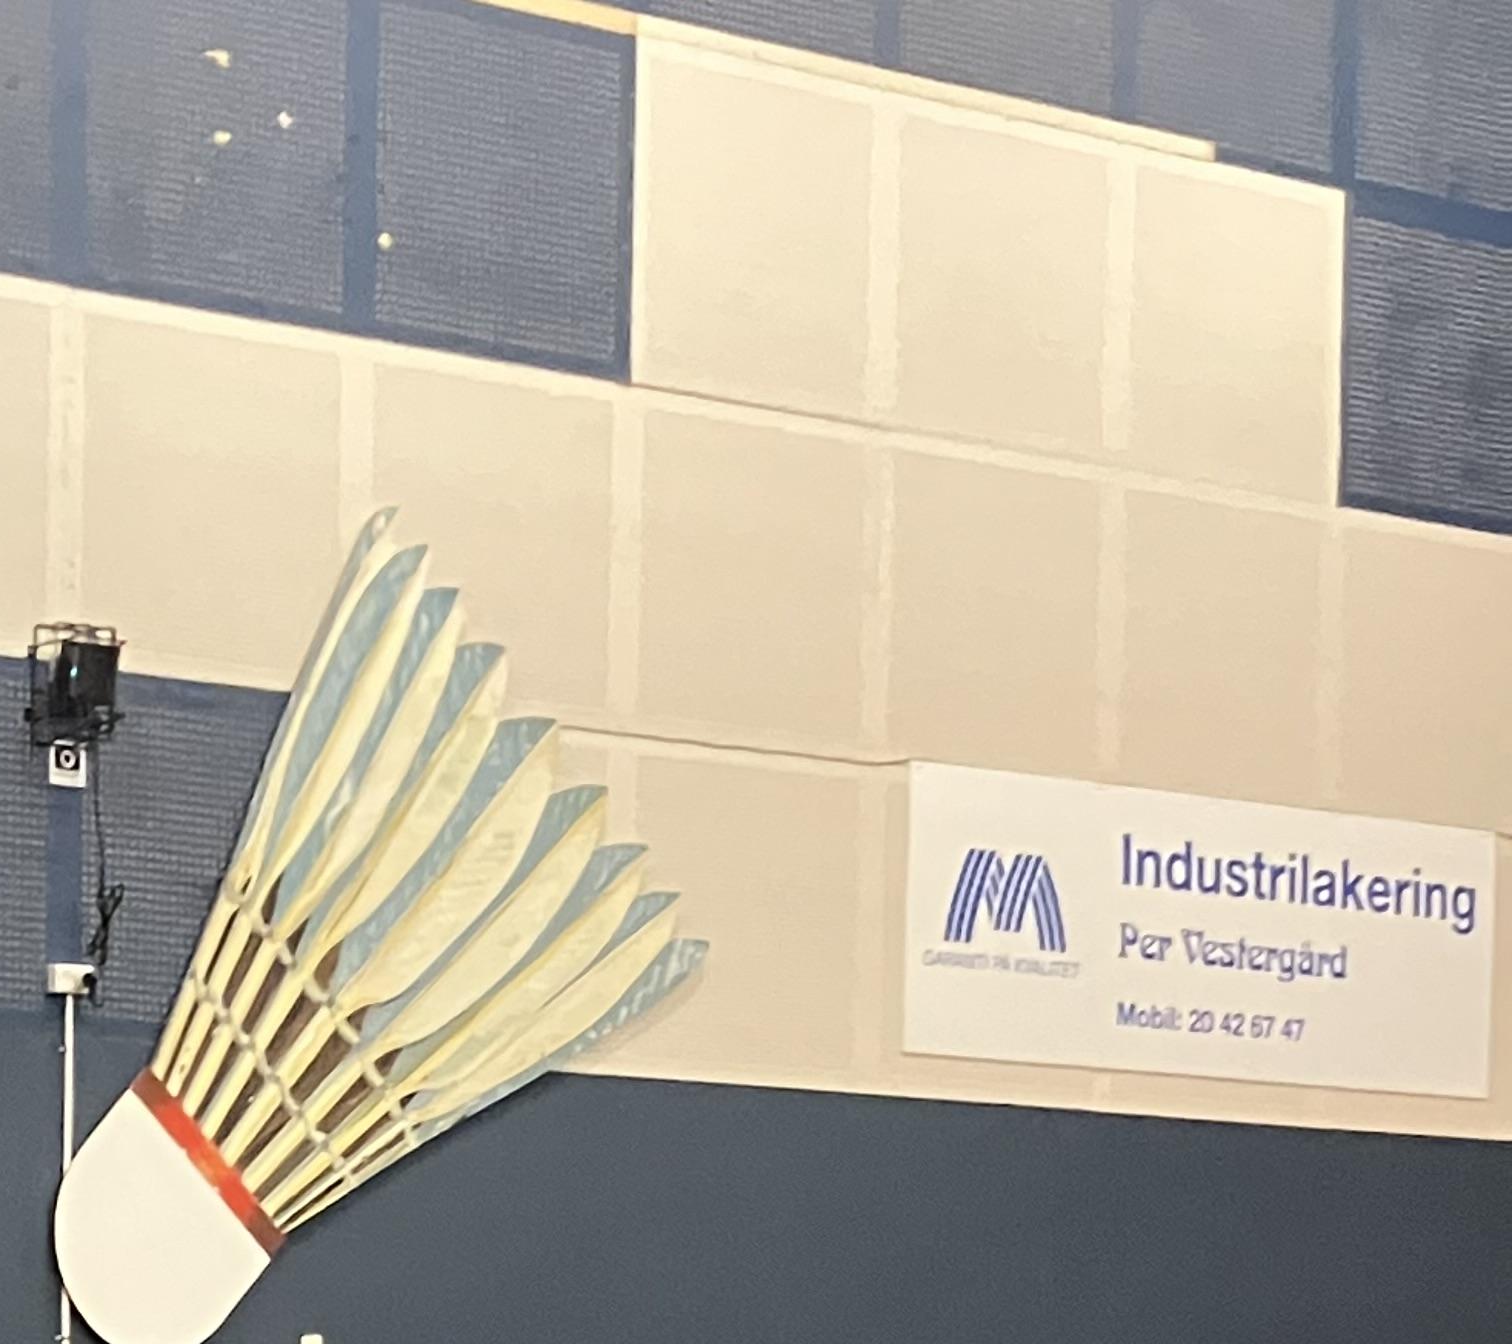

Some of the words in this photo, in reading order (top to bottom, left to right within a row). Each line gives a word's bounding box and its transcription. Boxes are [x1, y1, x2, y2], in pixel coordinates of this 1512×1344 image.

[1121, 832, 1477, 935] Industrilakering
[1117, 921, 1173, 962] Per
[1180, 927, 1348, 983] Vestergård
[1188, 1008, 1215, 1034] 20
[1219, 1012, 1245, 1037] 42
